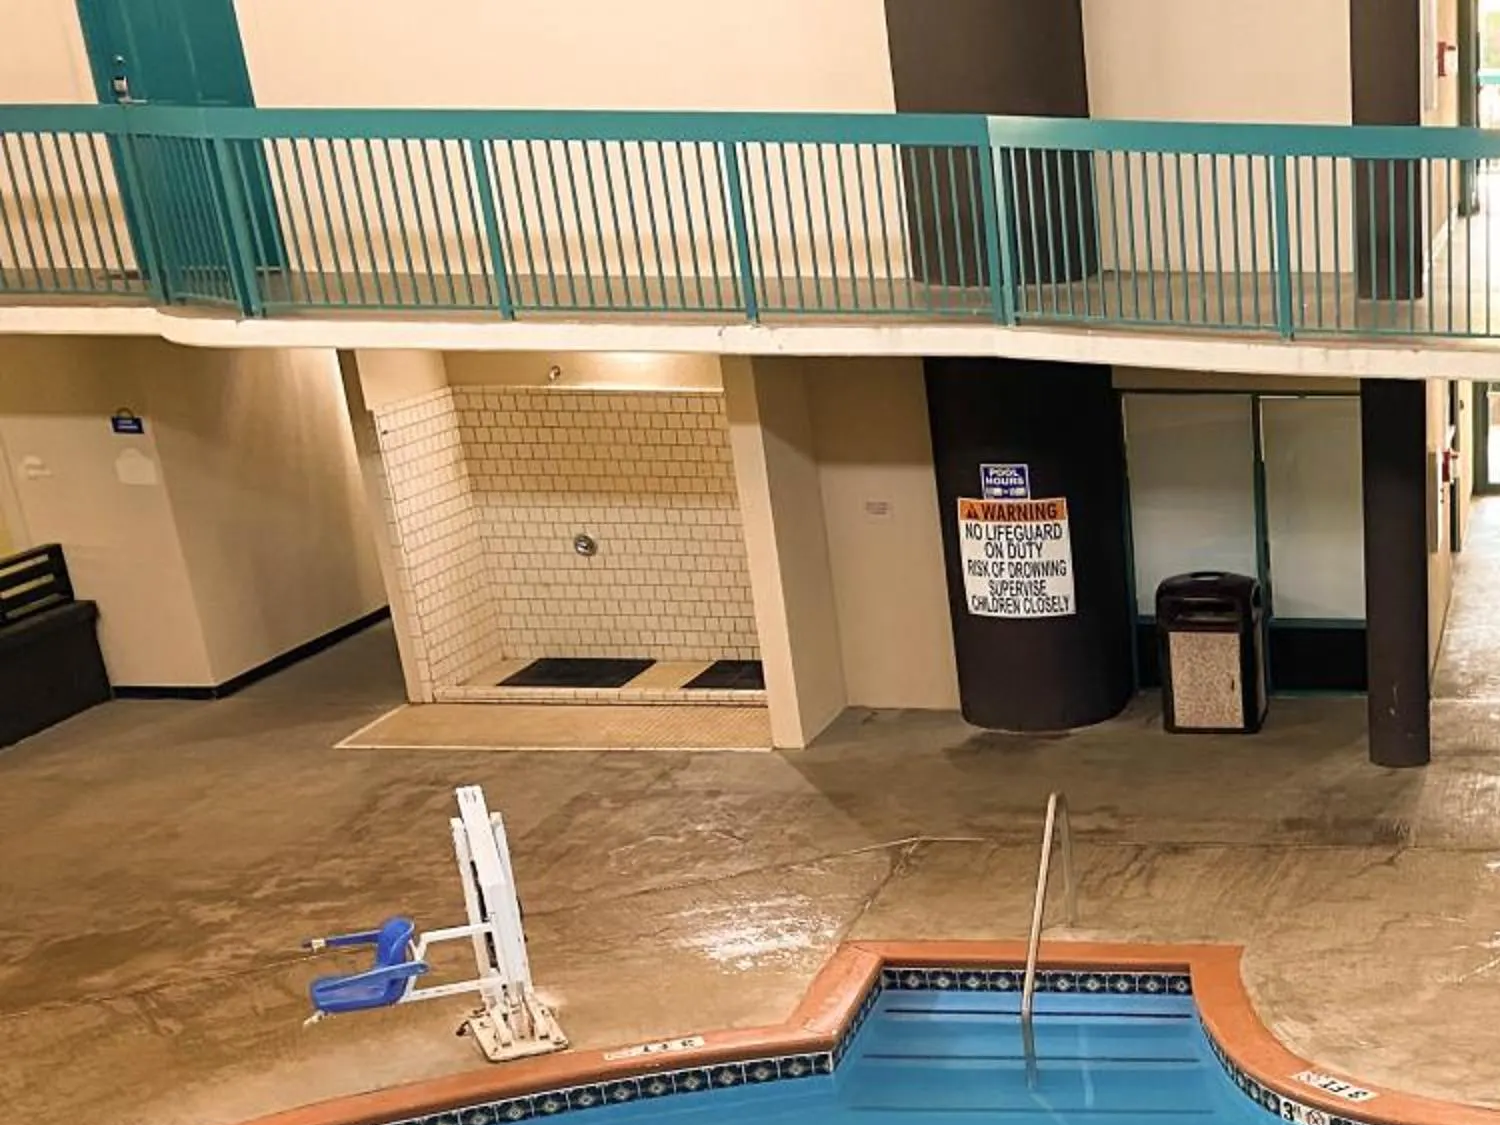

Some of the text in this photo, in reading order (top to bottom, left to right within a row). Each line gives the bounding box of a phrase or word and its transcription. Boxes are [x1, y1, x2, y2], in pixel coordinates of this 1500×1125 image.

[988, 467, 1019, 477] POOL
[985, 477, 1025, 485] HOURS
[981, 503, 1058, 520] WARNING
[965, 523, 1063, 540] NO LIFEGUARD
[984, 541, 1044, 560] ON DUTY
[967, 559, 1067, 578] RISK OF DROWNING
[988, 579, 1048, 597] SUPERVISE
[971, 595, 1070, 614] CHILDREN CLOSELY
